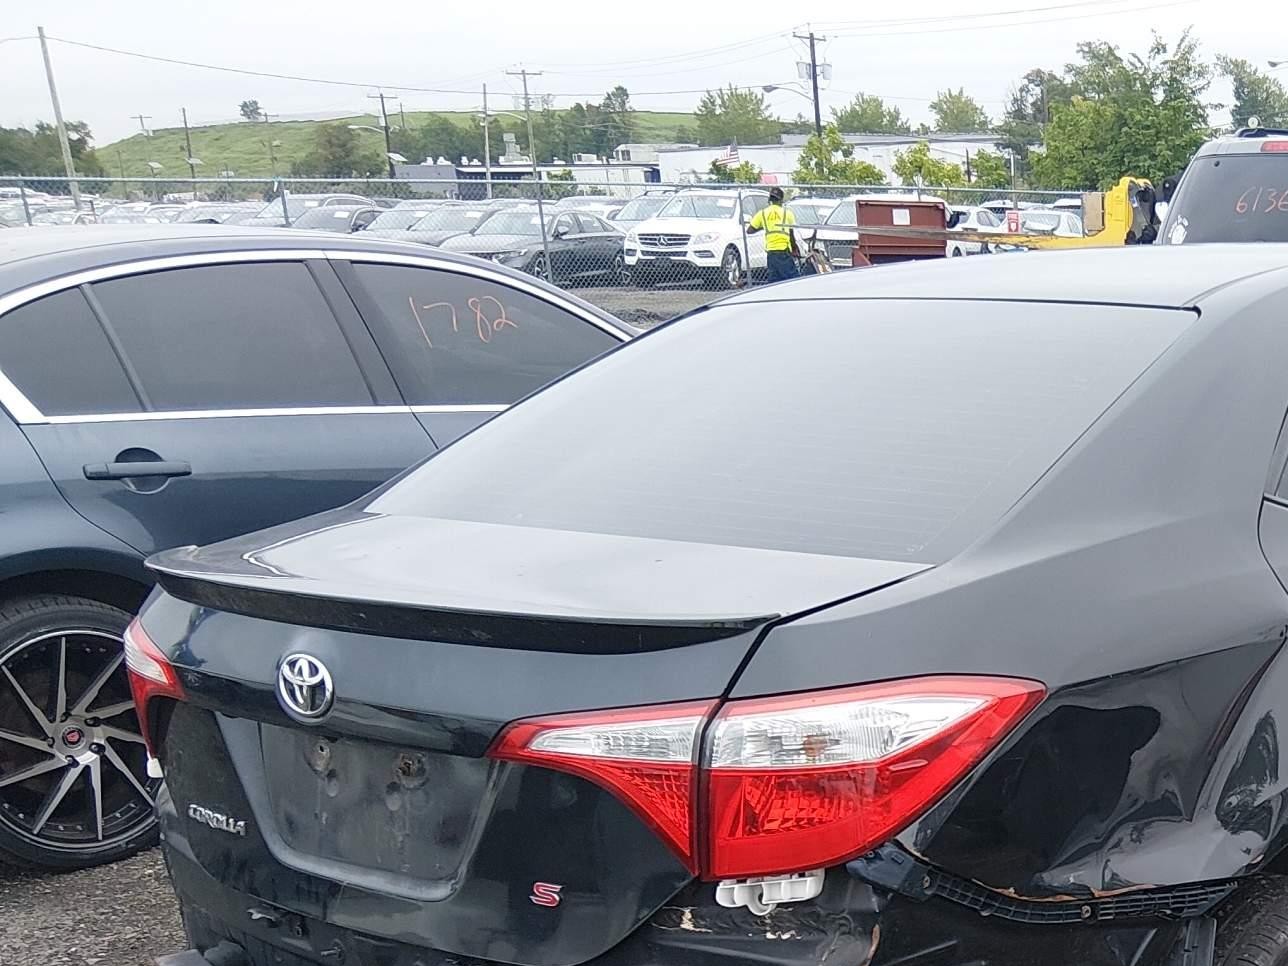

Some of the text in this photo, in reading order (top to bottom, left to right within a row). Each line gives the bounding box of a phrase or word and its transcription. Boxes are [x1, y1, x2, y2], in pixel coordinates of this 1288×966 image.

[408, 295, 519, 349] 1782
[187, 803, 247, 837] COROLLA
[529, 881, 562, 907] S
